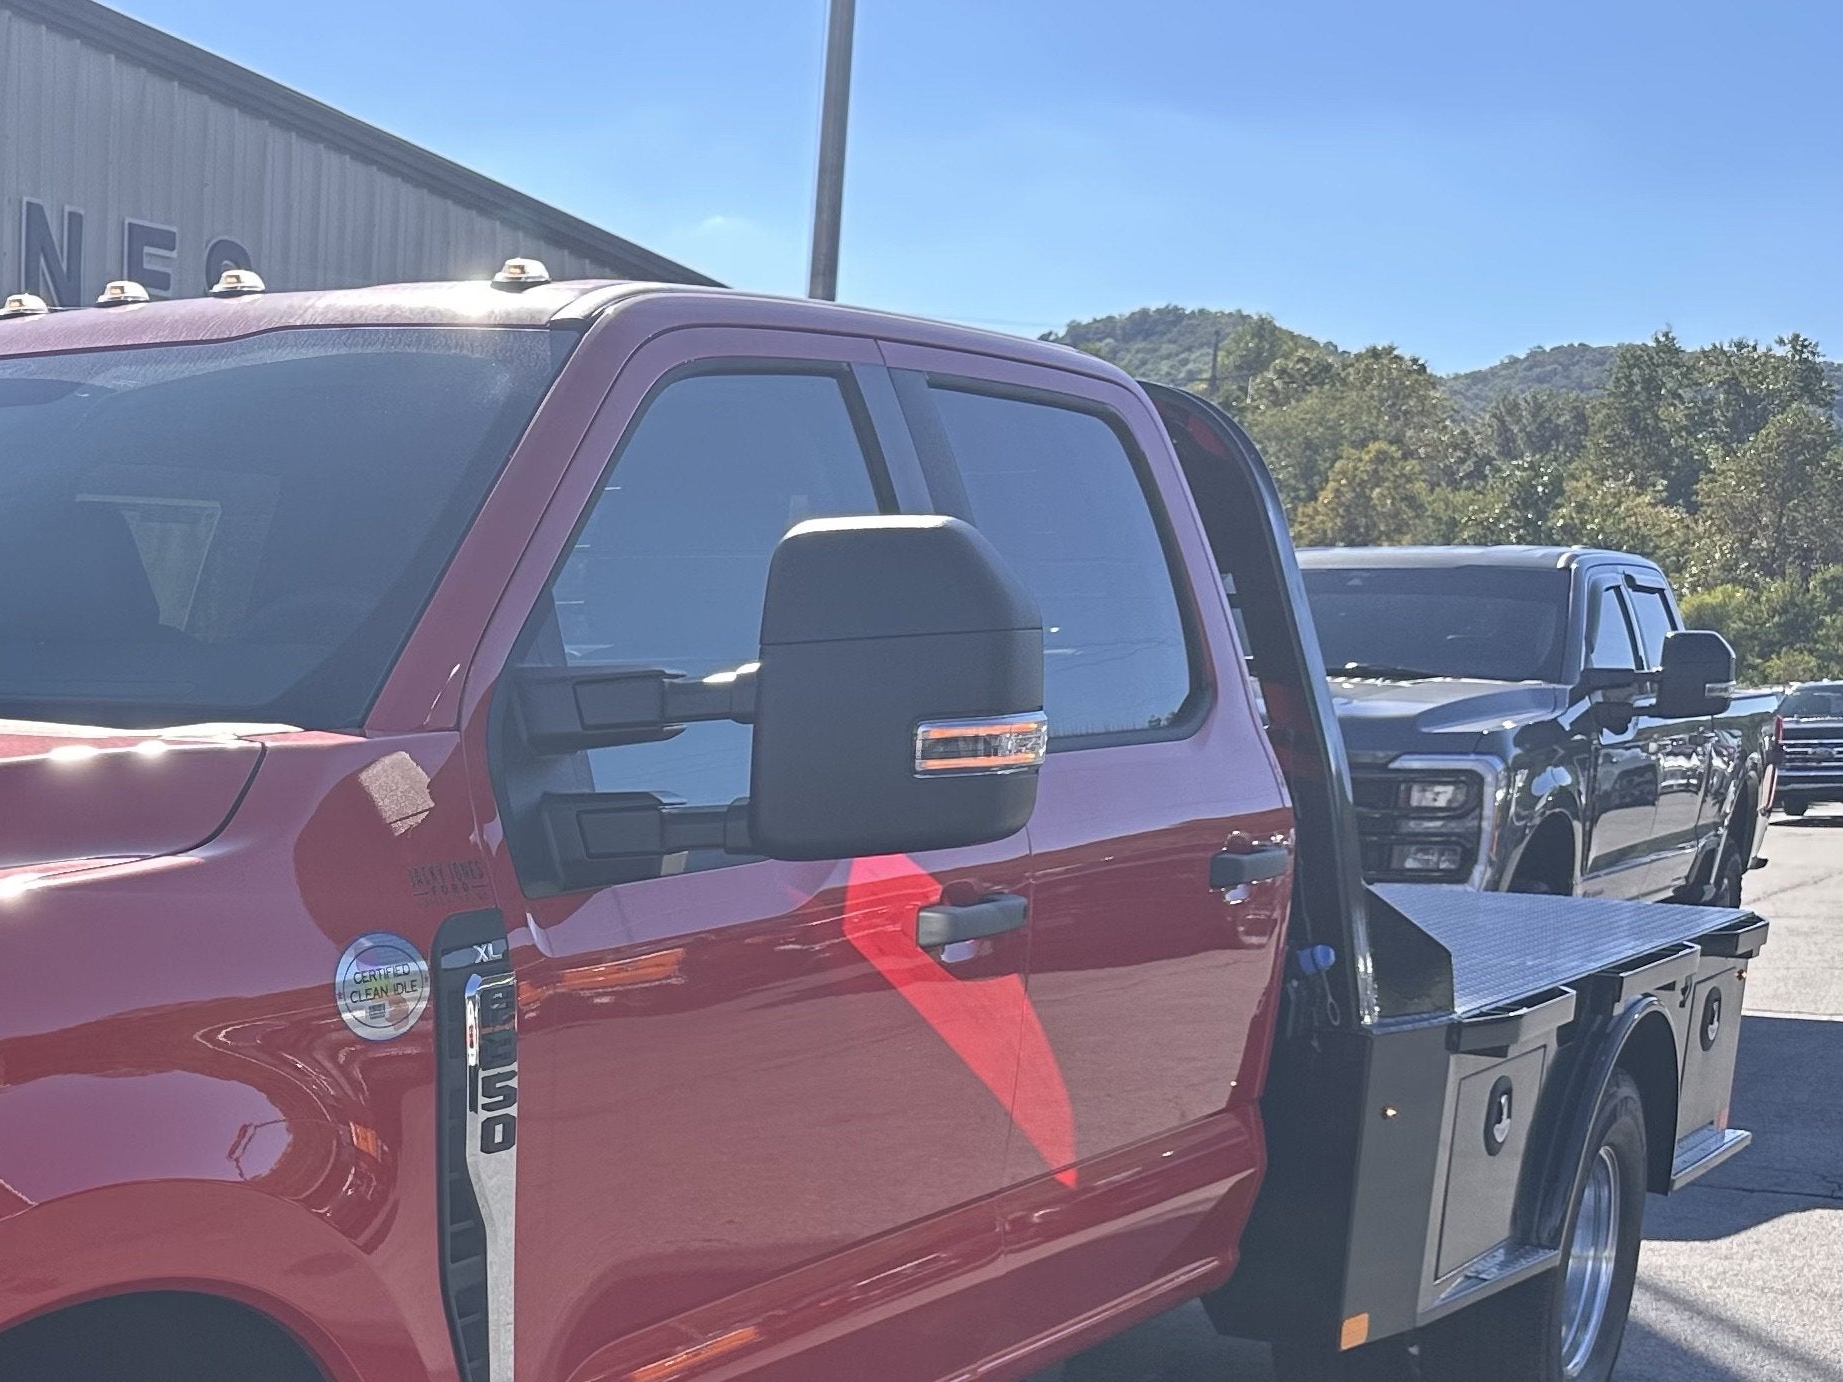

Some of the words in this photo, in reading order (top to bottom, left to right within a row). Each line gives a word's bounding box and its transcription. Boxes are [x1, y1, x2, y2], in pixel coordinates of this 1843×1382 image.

[473, 943, 502, 964] XL
[353, 963, 411, 986] CERTIFIED
[349, 985, 389, 1004] CLEAN
[392, 979, 418, 996] IDLE
